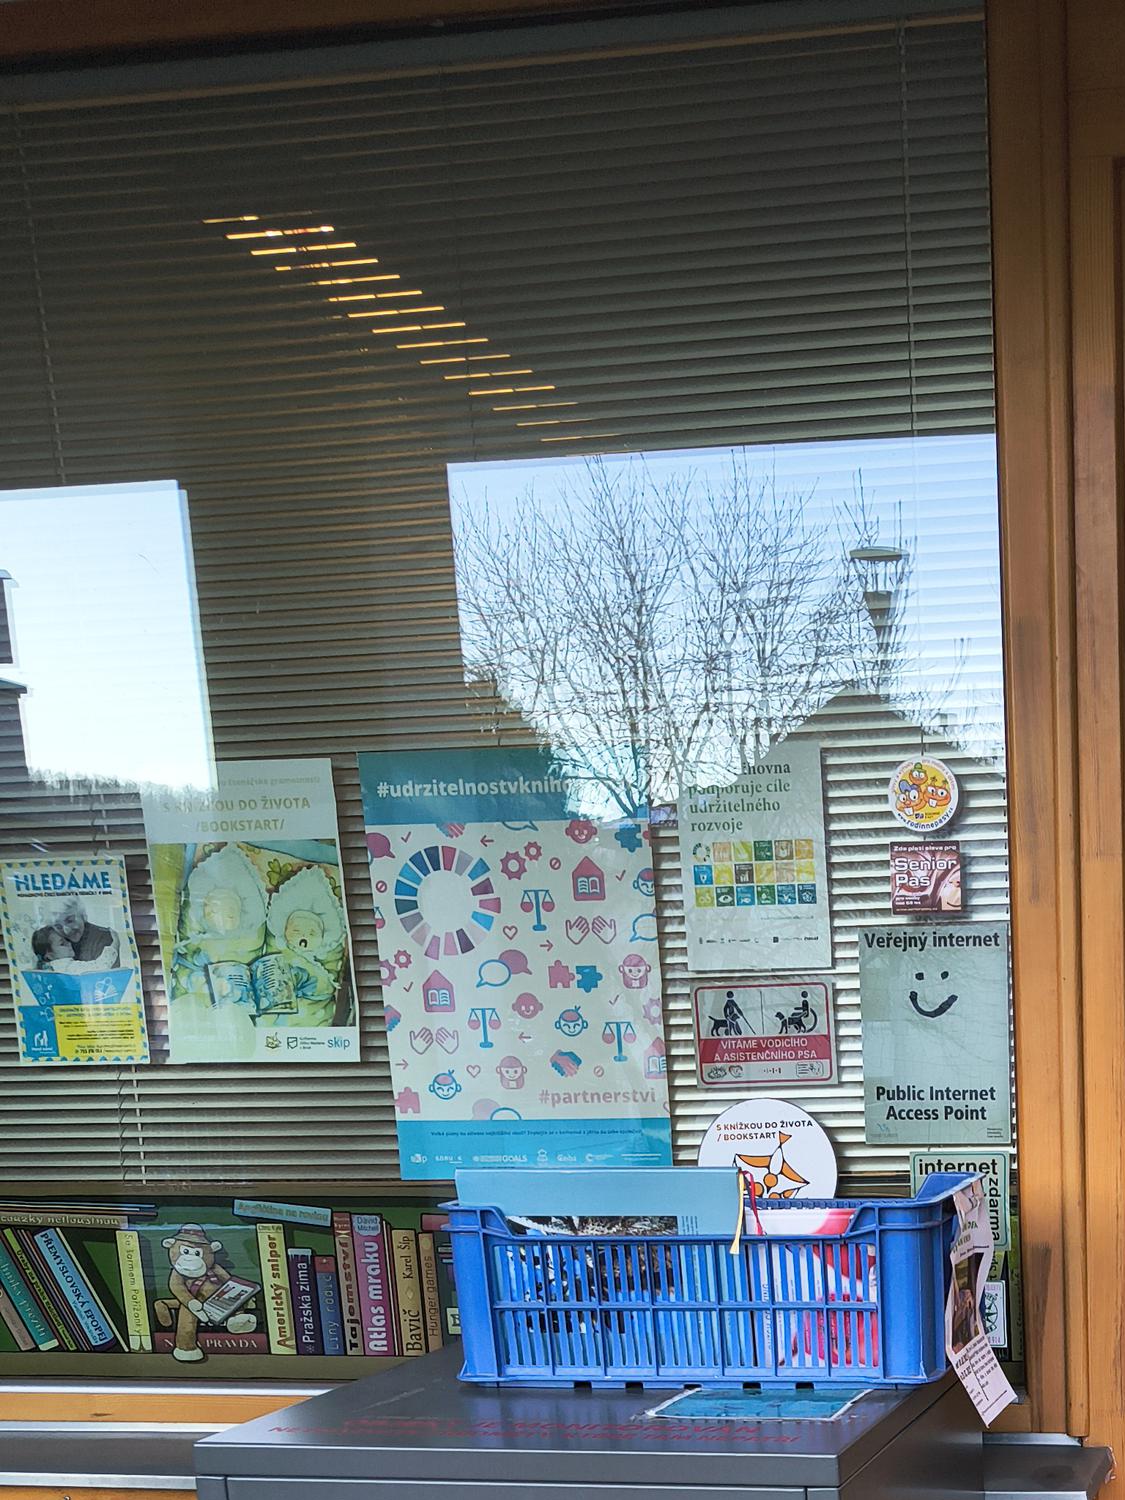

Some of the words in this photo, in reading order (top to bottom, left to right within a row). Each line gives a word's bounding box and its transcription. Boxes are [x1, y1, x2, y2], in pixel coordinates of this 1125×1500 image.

[766, 780, 790, 793] cíle
[261, 796, 311, 809] ŽIVOTA
[689, 798, 780, 813] udržitelného
[691, 818, 743, 834] rozvoje
[895, 857, 957, 871] Senior
[14, 867, 112, 892] HLEDÁME
[895, 873, 931, 887] Pas
[864, 932, 927, 952] Veřejný
[932, 931, 1000, 948] internet
[721, 1039, 758, 1049] VÍTÁME
[760, 1038, 808, 1048] VODICÍHO
[723, 1050, 795, 1061] ASISTENČNÍHO
[797, 1050, 817, 1059] PSA
[876, 1085, 925, 1101] Public
[930, 1086, 996, 1101] Internet
[886, 1106, 939, 1121] Access
[944, 1105, 988, 1121] Point
[724, 1122, 762, 1131] KNÍŽKOU
[780, 1120, 813, 1128] ŽIVOTA
[724, 1132, 776, 1141] BOOKSTART
[919, 1159, 997, 1176] internet
[989, 1178, 1002, 1241] zdarma
[0, 1213, 43, 1225] couzky
[397, 1235, 415, 1251] Šíp
[267, 1234, 280, 1279] sniper
[400, 1255, 413, 1279] Karel
[424, 1256, 436, 1290] games
[296, 1262, 310, 1291] zima
[40, 1232, 90, 1308] PŘEMYSLOVSKÁ
[84, 1308, 108, 1342] EPOPEJ
[338, 1239, 361, 1351] Tajemství
[271, 1283, 288, 1350] Americký
[298, 1294, 315, 1343] Pražská
[428, 1297, 439, 1337] Hunger
[368, 1305, 389, 1352] Atlas
[402, 1310, 423, 1352] Bavič
[206, 1339, 257, 1348] PRAVDA
